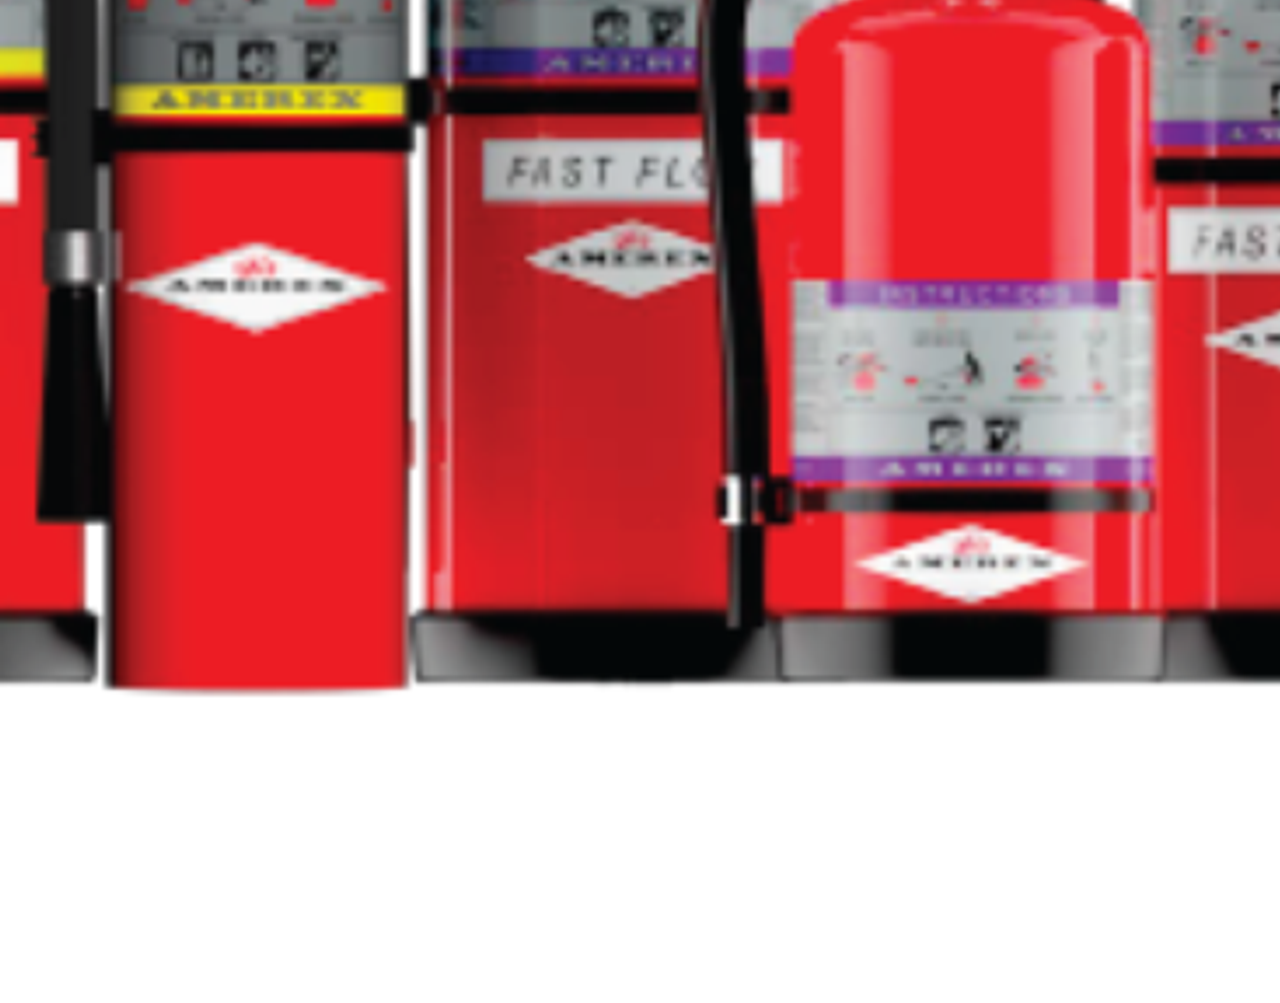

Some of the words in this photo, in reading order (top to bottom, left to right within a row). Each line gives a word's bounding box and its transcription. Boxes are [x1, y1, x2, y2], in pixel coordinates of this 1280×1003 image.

[152, 90, 364, 109] AMEREX
[506, 155, 614, 189] FAST
[635, 155, 708, 189] FLO
[164, 278, 346, 293] AMEREX
